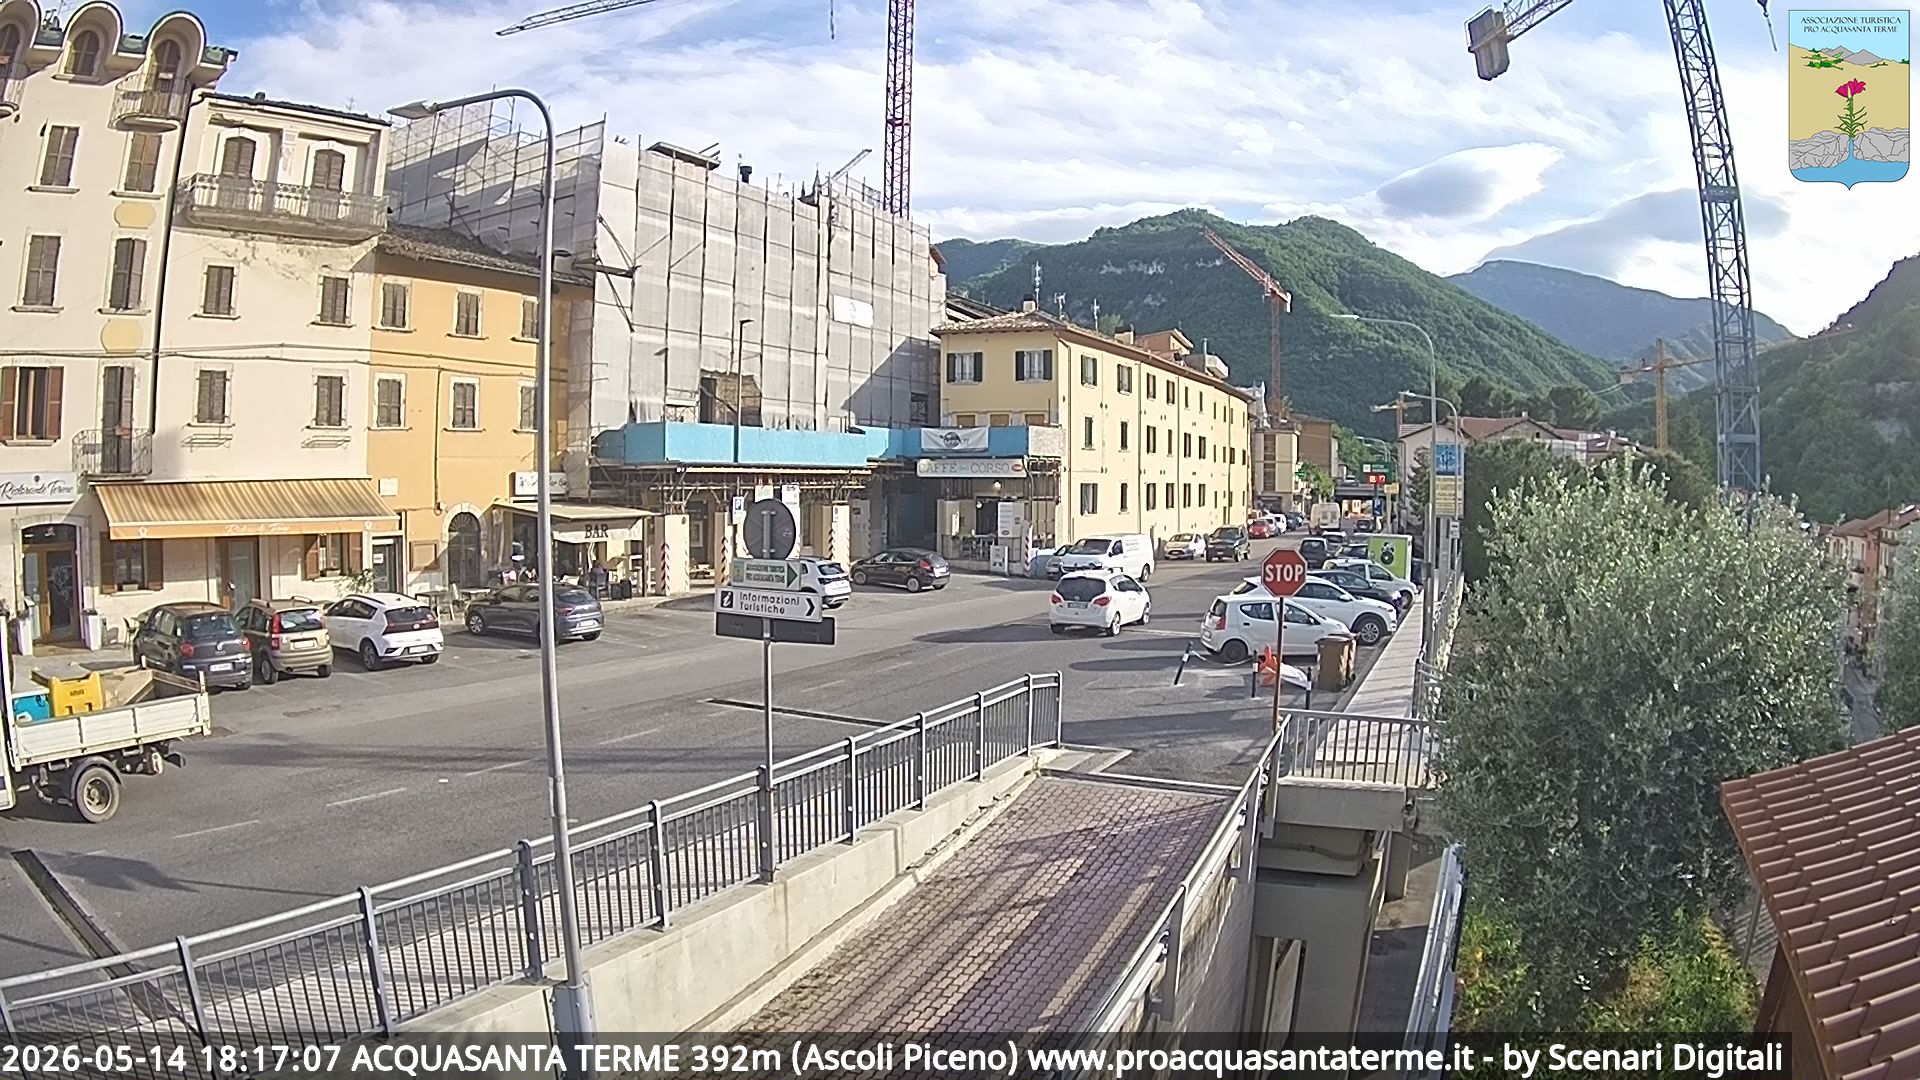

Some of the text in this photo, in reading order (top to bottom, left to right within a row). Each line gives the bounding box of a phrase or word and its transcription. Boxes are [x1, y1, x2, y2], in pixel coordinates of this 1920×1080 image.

[971, 462, 1009, 474] CORSO
[584, 524, 609, 538] BAR
[1265, 564, 1303, 582] STOP
[740, 592, 800, 606] Informazioni
[740, 602, 785, 615] Turistiche
